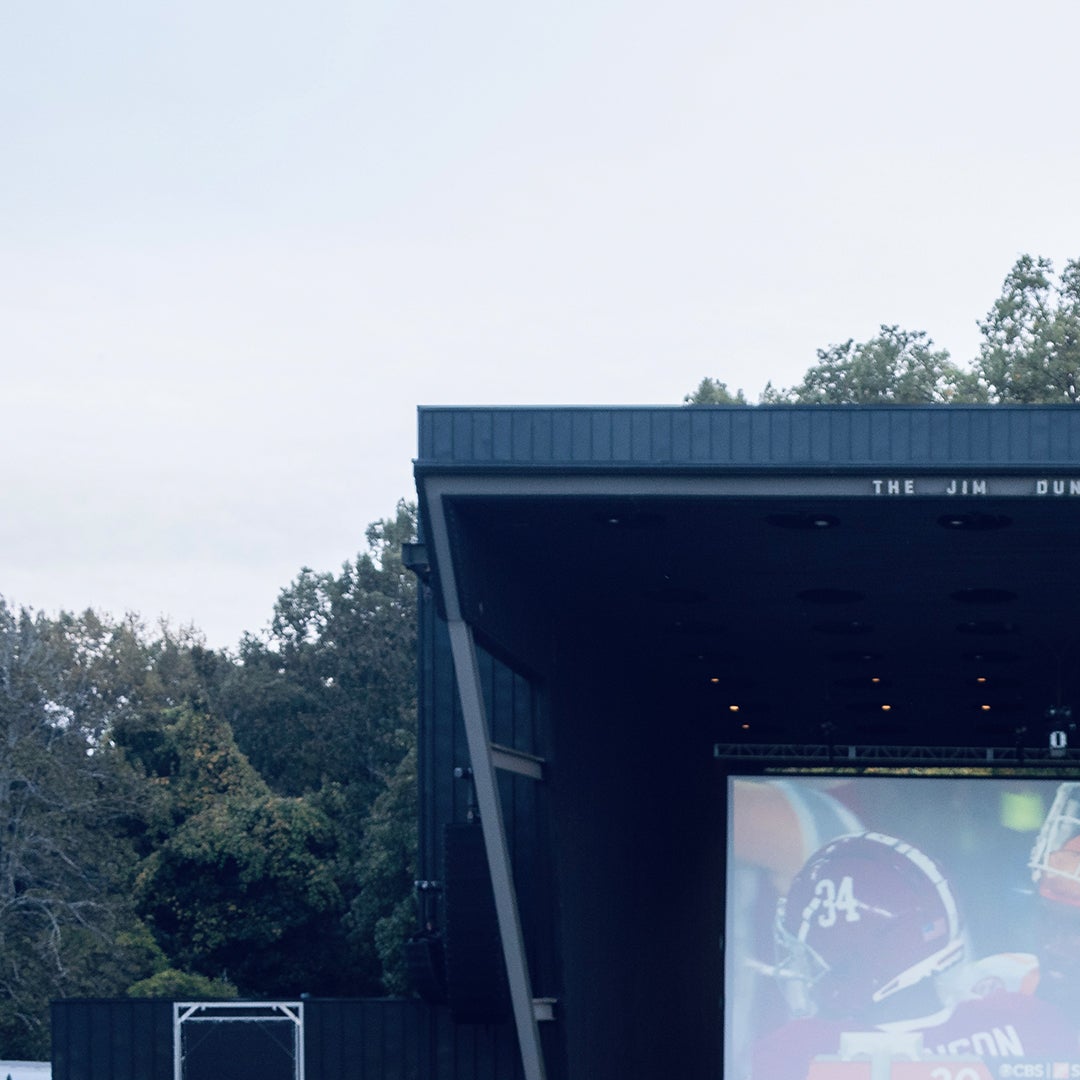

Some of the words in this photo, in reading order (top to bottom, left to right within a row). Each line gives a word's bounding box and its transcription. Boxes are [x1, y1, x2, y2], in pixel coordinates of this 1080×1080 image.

[872, 479, 916, 495] THE
[946, 479, 988, 495] JIM
[815, 876, 860, 928] 34
[1013, 1063, 1044, 1078] CBS
